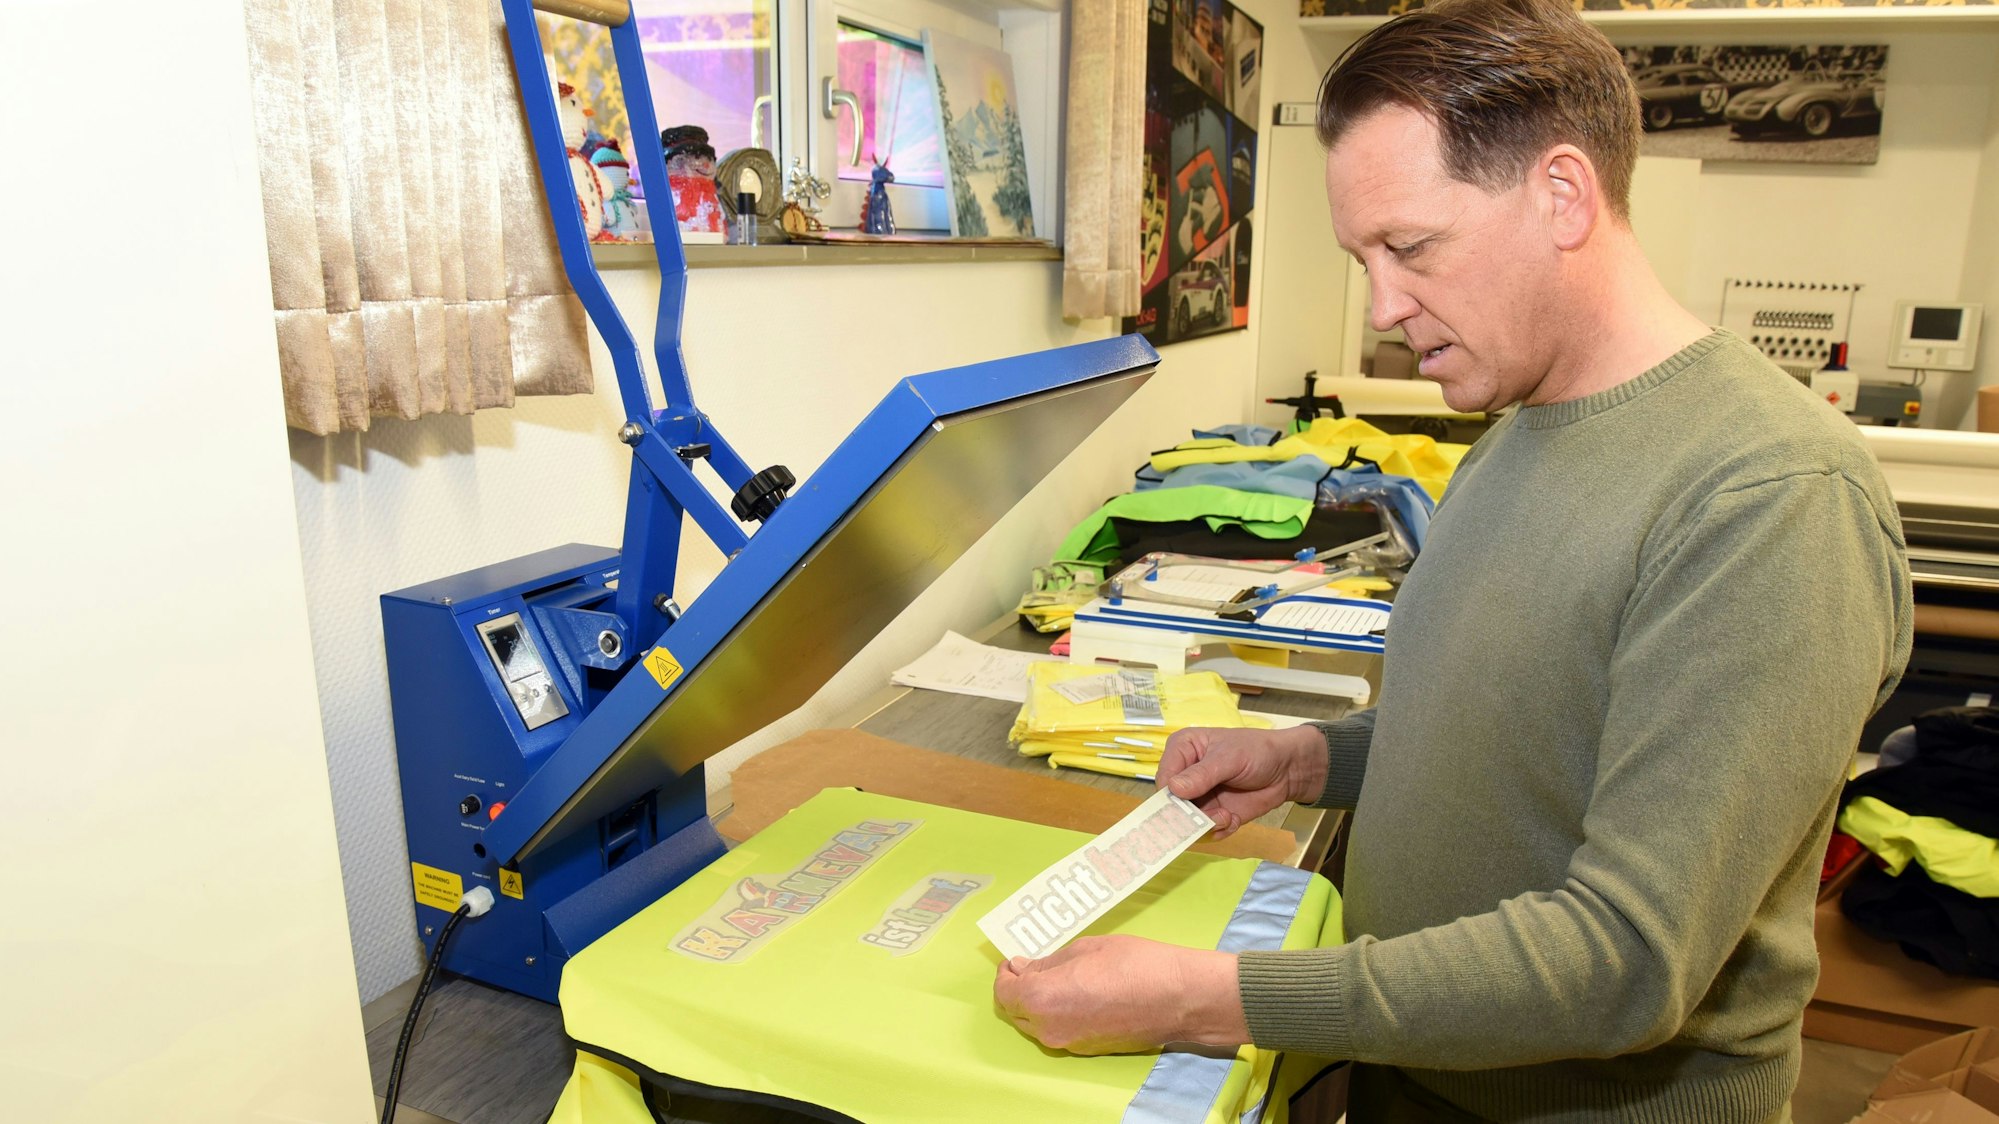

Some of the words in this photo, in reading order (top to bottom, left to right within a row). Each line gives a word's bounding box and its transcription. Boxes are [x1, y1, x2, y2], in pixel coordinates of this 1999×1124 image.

[1704, 87, 1724, 110] 37
[487, 607, 501, 616] Timer
[424, 872, 450, 885] WARNING
[1005, 861, 1114, 957] nicht
[1083, 791, 1208, 892] braun!
[677, 822, 913, 960] KARNEVAL
[863, 918, 930, 950] ist
